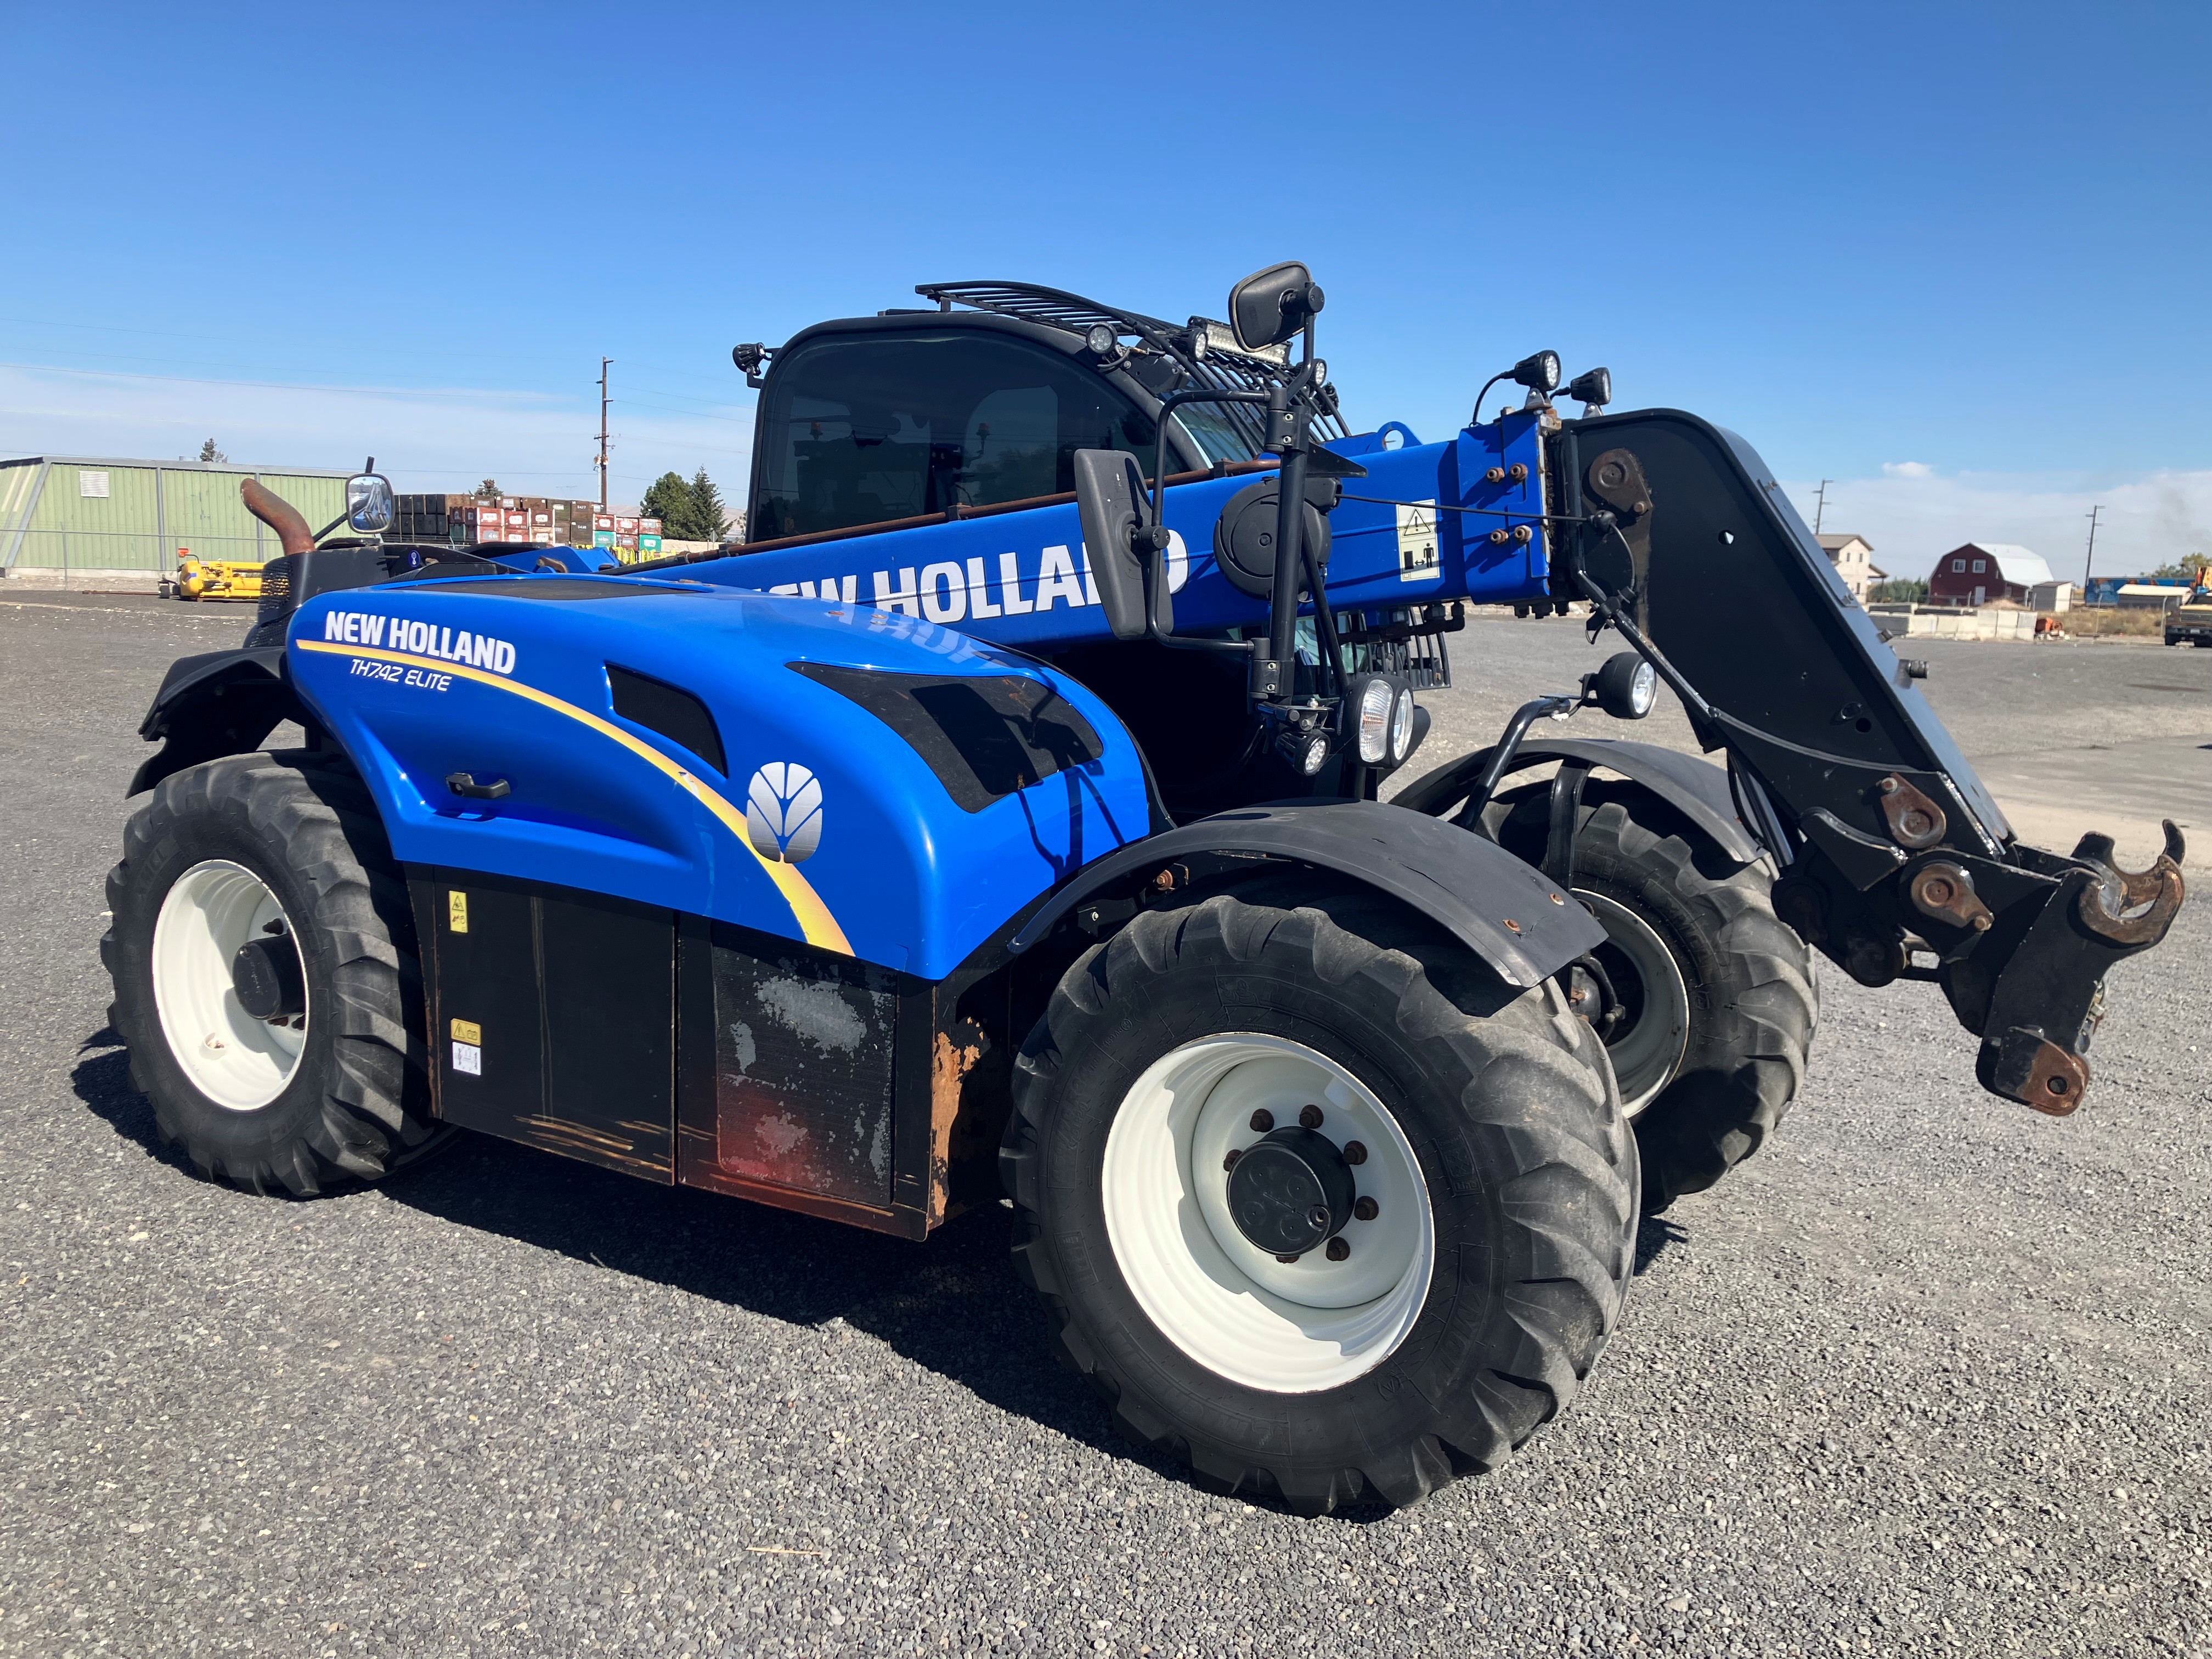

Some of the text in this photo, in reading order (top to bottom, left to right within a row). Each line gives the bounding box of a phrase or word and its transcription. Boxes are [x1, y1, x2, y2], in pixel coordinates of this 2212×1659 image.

[325, 611, 516, 674] NEW HOLLAND
[404, 669, 453, 691] ELITE
